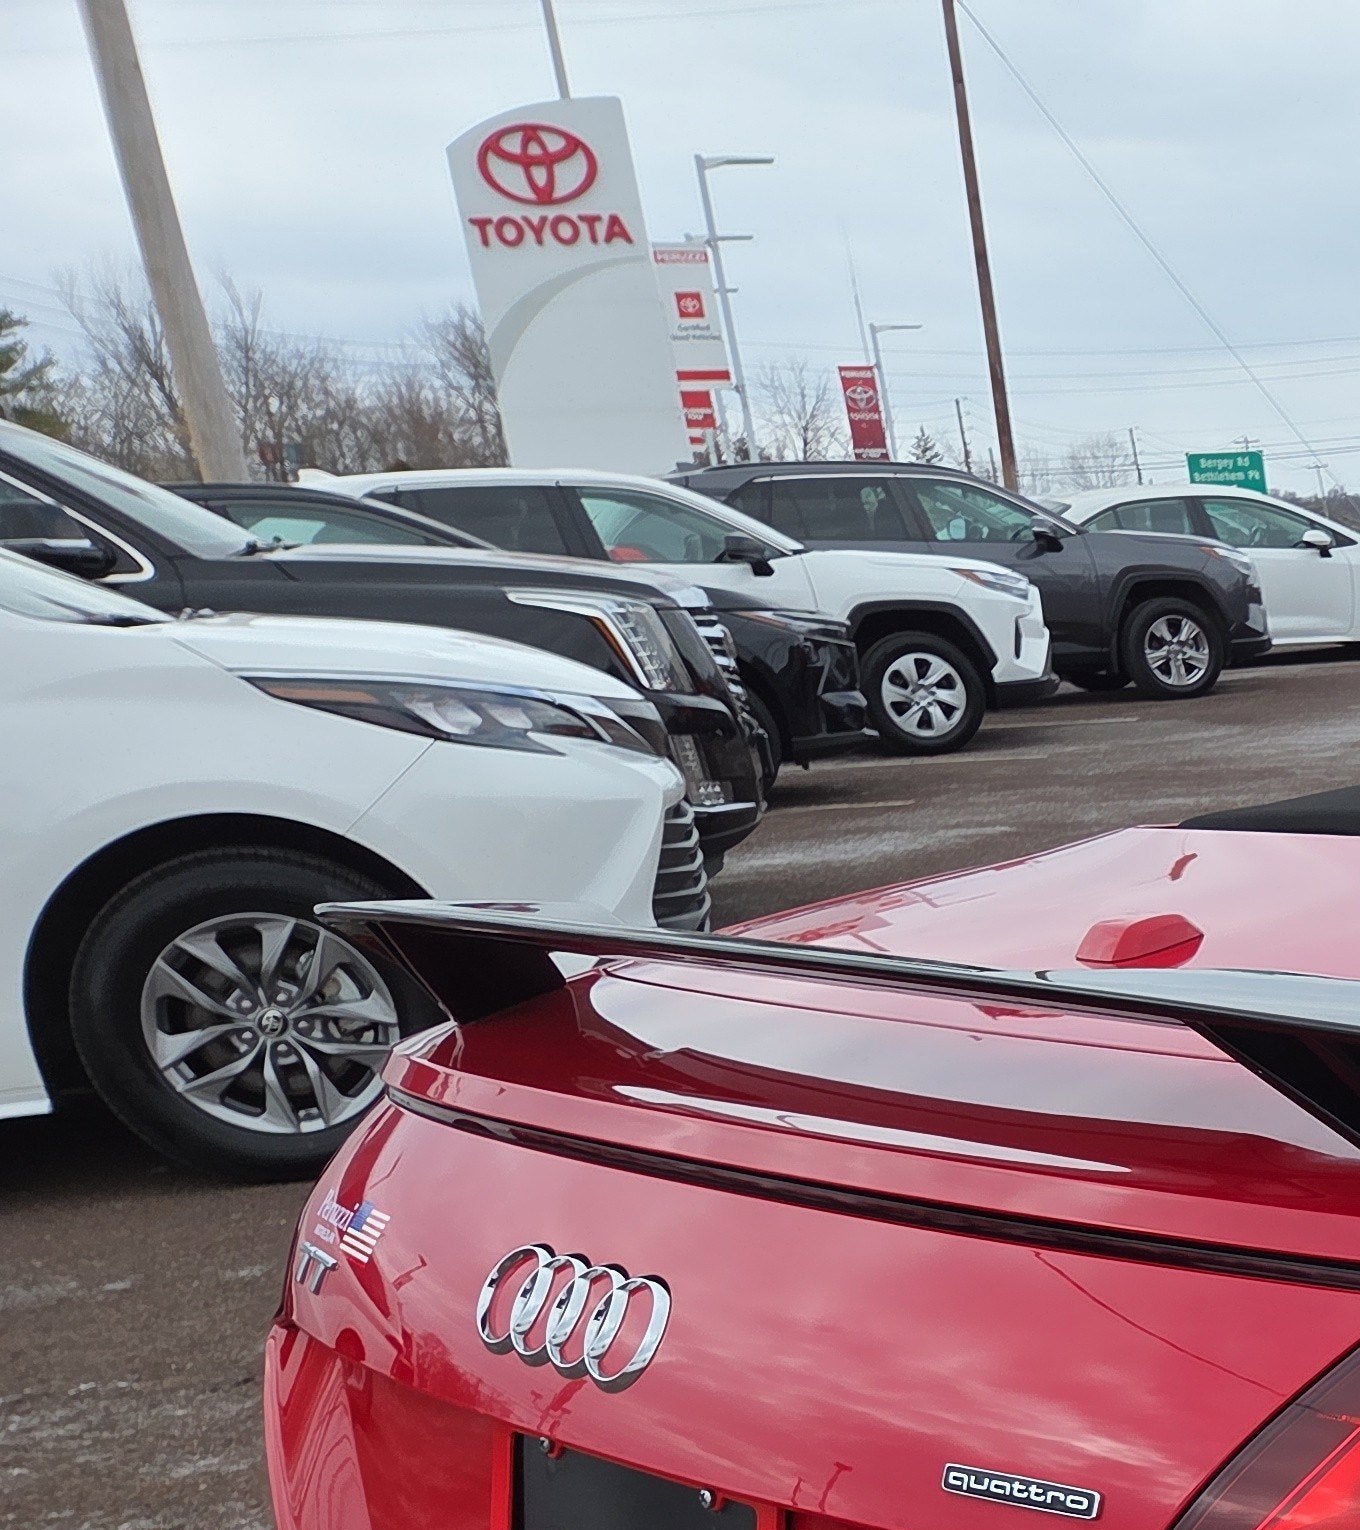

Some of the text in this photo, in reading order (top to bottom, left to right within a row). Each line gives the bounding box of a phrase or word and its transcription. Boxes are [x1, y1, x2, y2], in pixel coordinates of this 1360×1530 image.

[467, 213, 634, 248] TOYOTA
[295, 1241, 338, 1296] TT
[948, 1471, 1089, 1511] quattro
